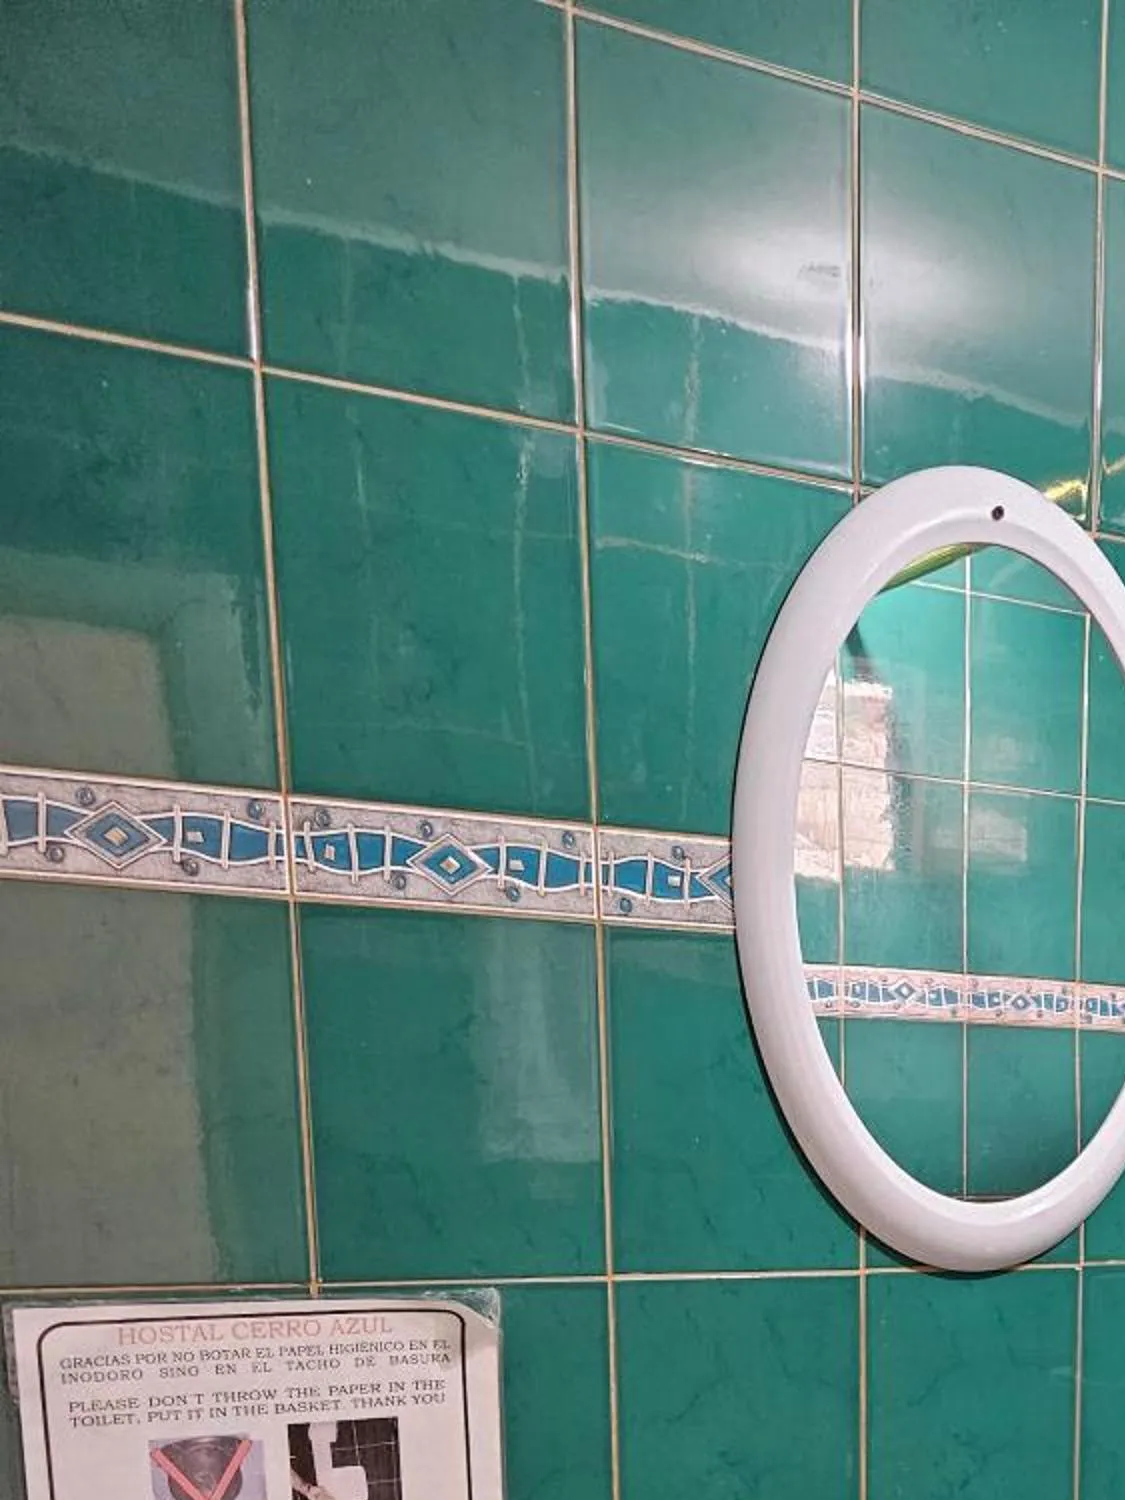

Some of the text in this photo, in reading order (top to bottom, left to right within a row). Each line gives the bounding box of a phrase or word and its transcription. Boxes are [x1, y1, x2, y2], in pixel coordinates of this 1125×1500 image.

[118, 1316, 392, 1346] HOSTAL CERRO AZUL
[59, 1353, 131, 1370] GRACIAS
[135, 1352, 168, 1365] POR
[172, 1350, 195, 1363] NO
[199, 1347, 252, 1361] BOTAR
[255, 1347, 274, 1359] EL
[279, 1344, 324, 1357] PAPEL
[409, 1339, 428, 1351] EN
[433, 1339, 451, 1350] EL
[60, 1353, 451, 1385] INODORO SINO EN EL TACHO DE BASURA
[69, 1397, 141, 1413] PLEASE
[212, 1388, 277, 1403] THROW
[284, 1386, 321, 1399] THE
[328, 1382, 382, 1397] PAPER
[388, 1381, 406, 1393] IN
[412, 1379, 446, 1392] THE
[147, 1409, 182, 1423] PUT
[187, 1408, 204, 1421] IT
[209, 1406, 227, 1419] IN
[231, 1403, 269, 1417] THE
[349, 1394, 407, 1409] THANK
[411, 1392, 446, 1405] YOU
